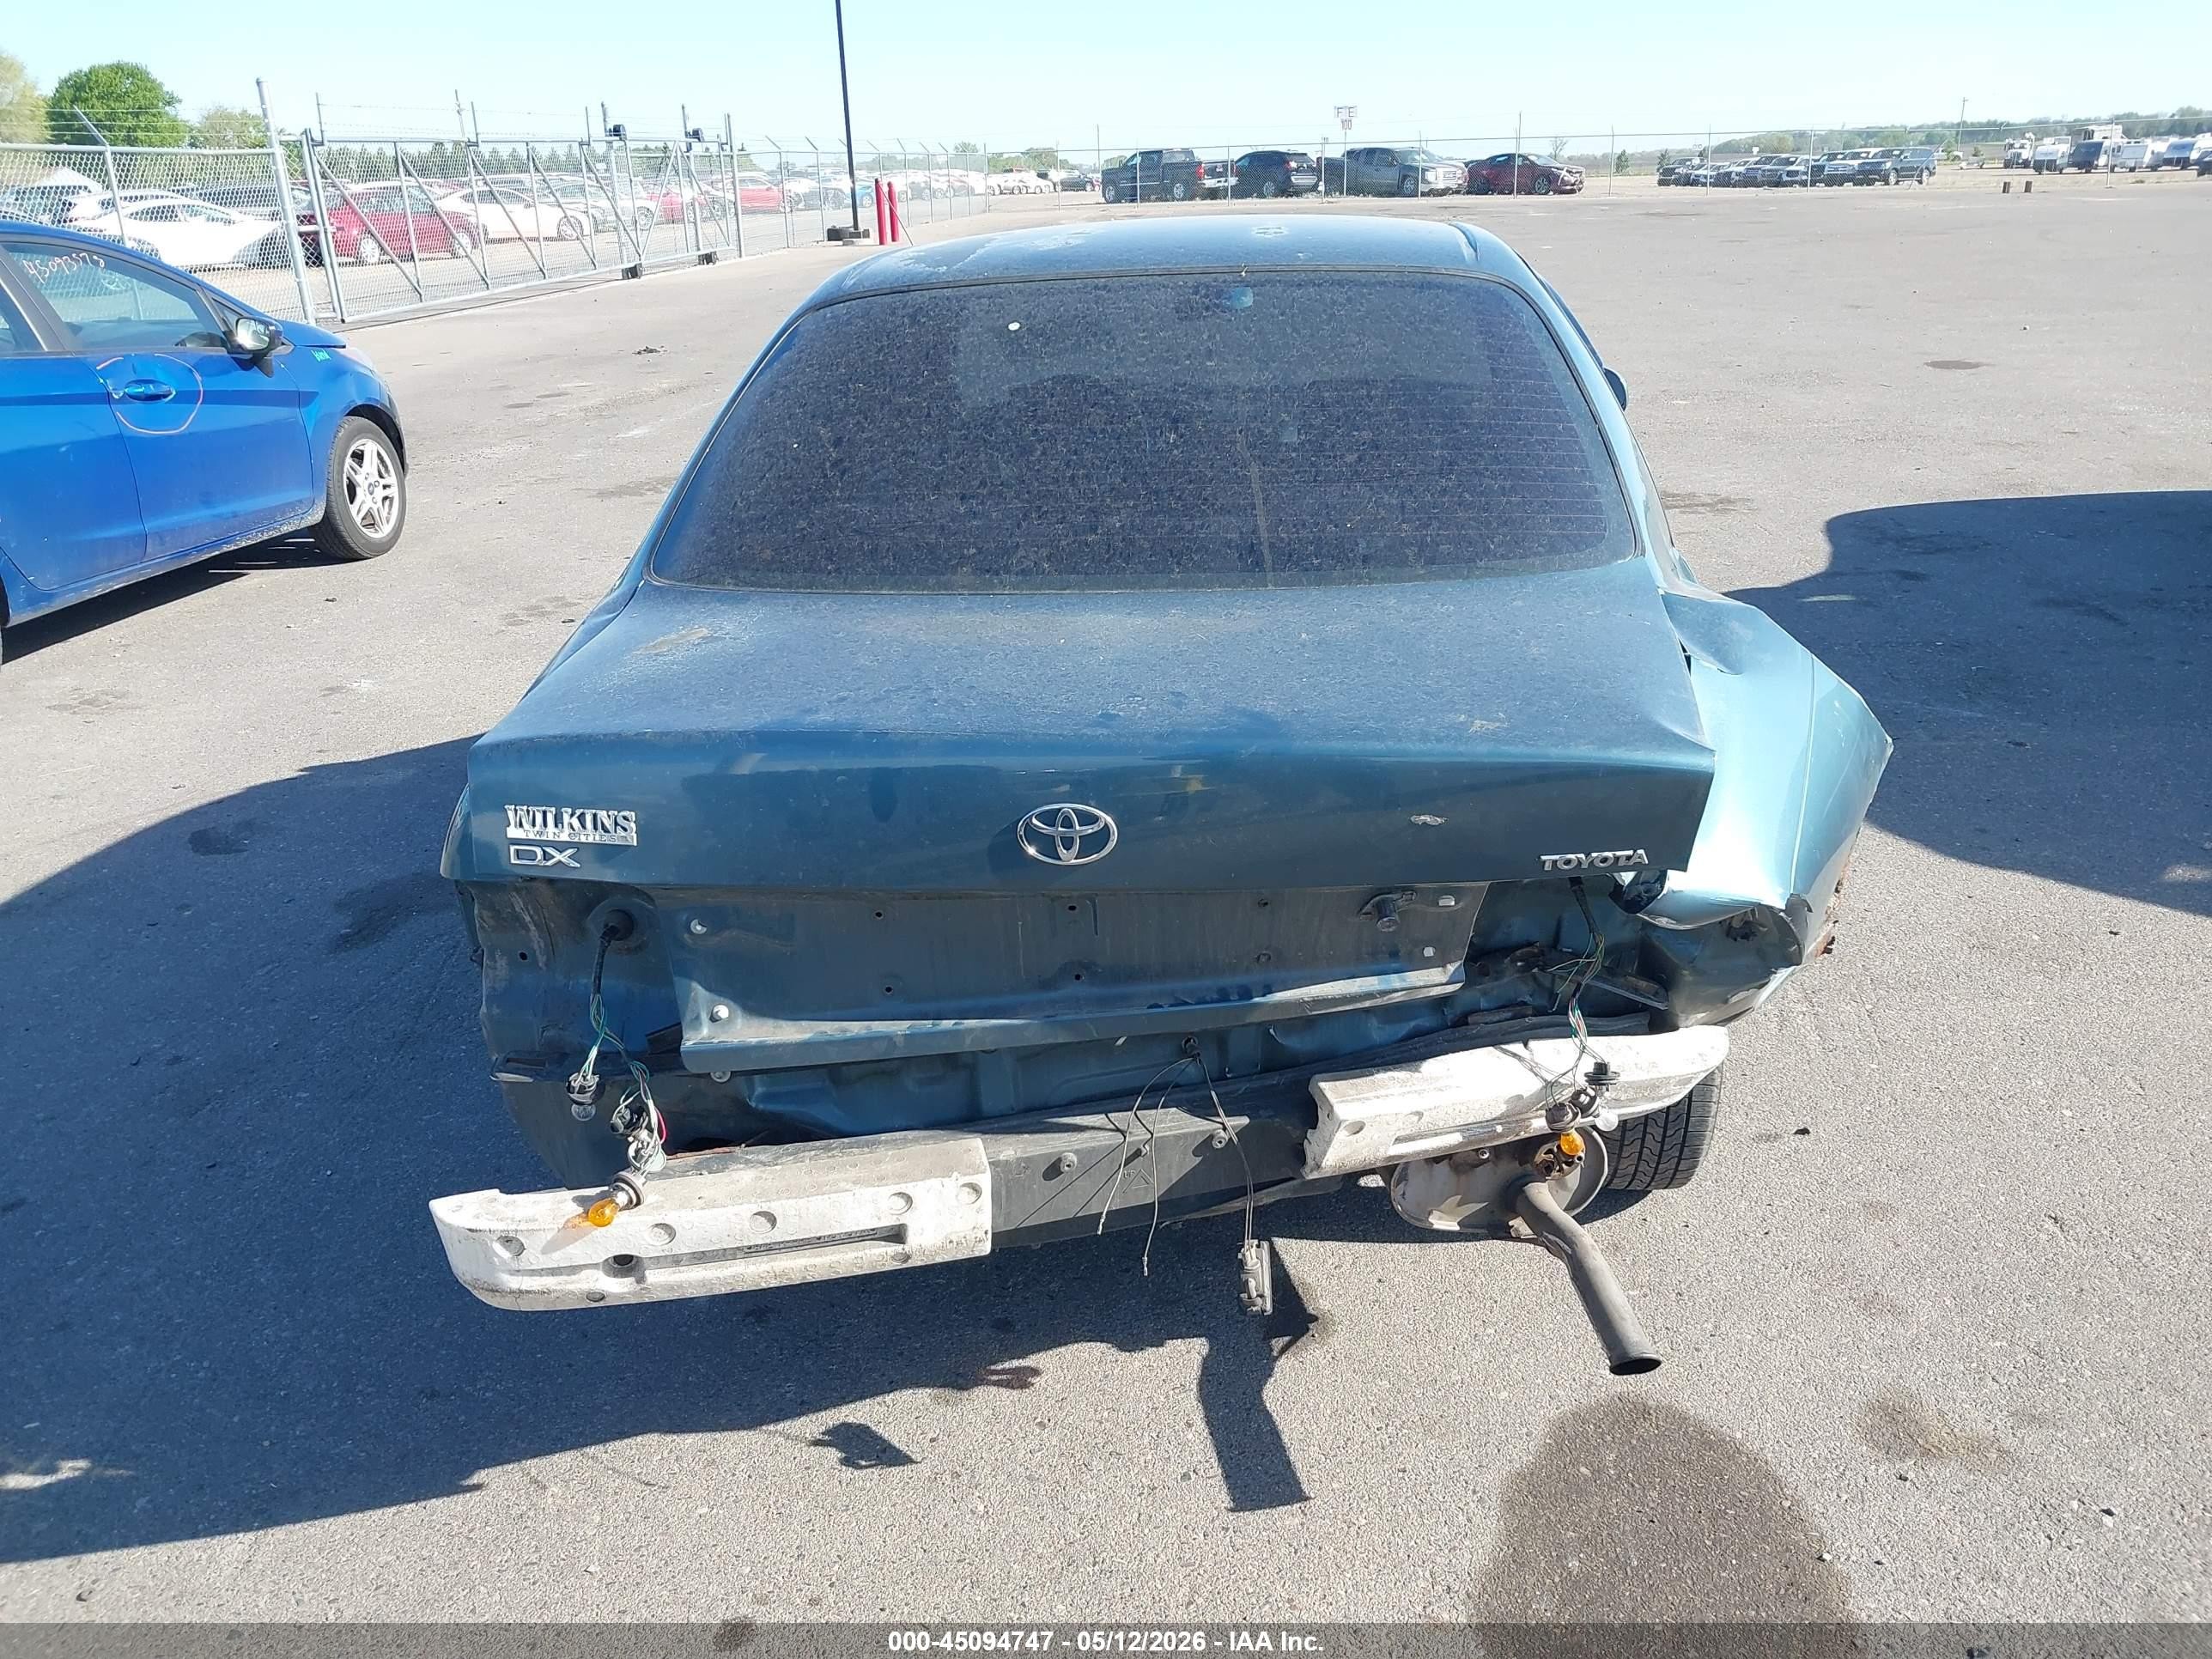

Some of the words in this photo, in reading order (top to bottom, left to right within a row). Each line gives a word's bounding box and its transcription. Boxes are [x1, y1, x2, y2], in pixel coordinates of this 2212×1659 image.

[504, 804, 636, 835] WILKINS
[523, 830, 562, 839] TWIN
[568, 832, 618, 842] CITIES
[508, 843, 581, 868] DX
[1540, 848, 1649, 871] TOYOTA
